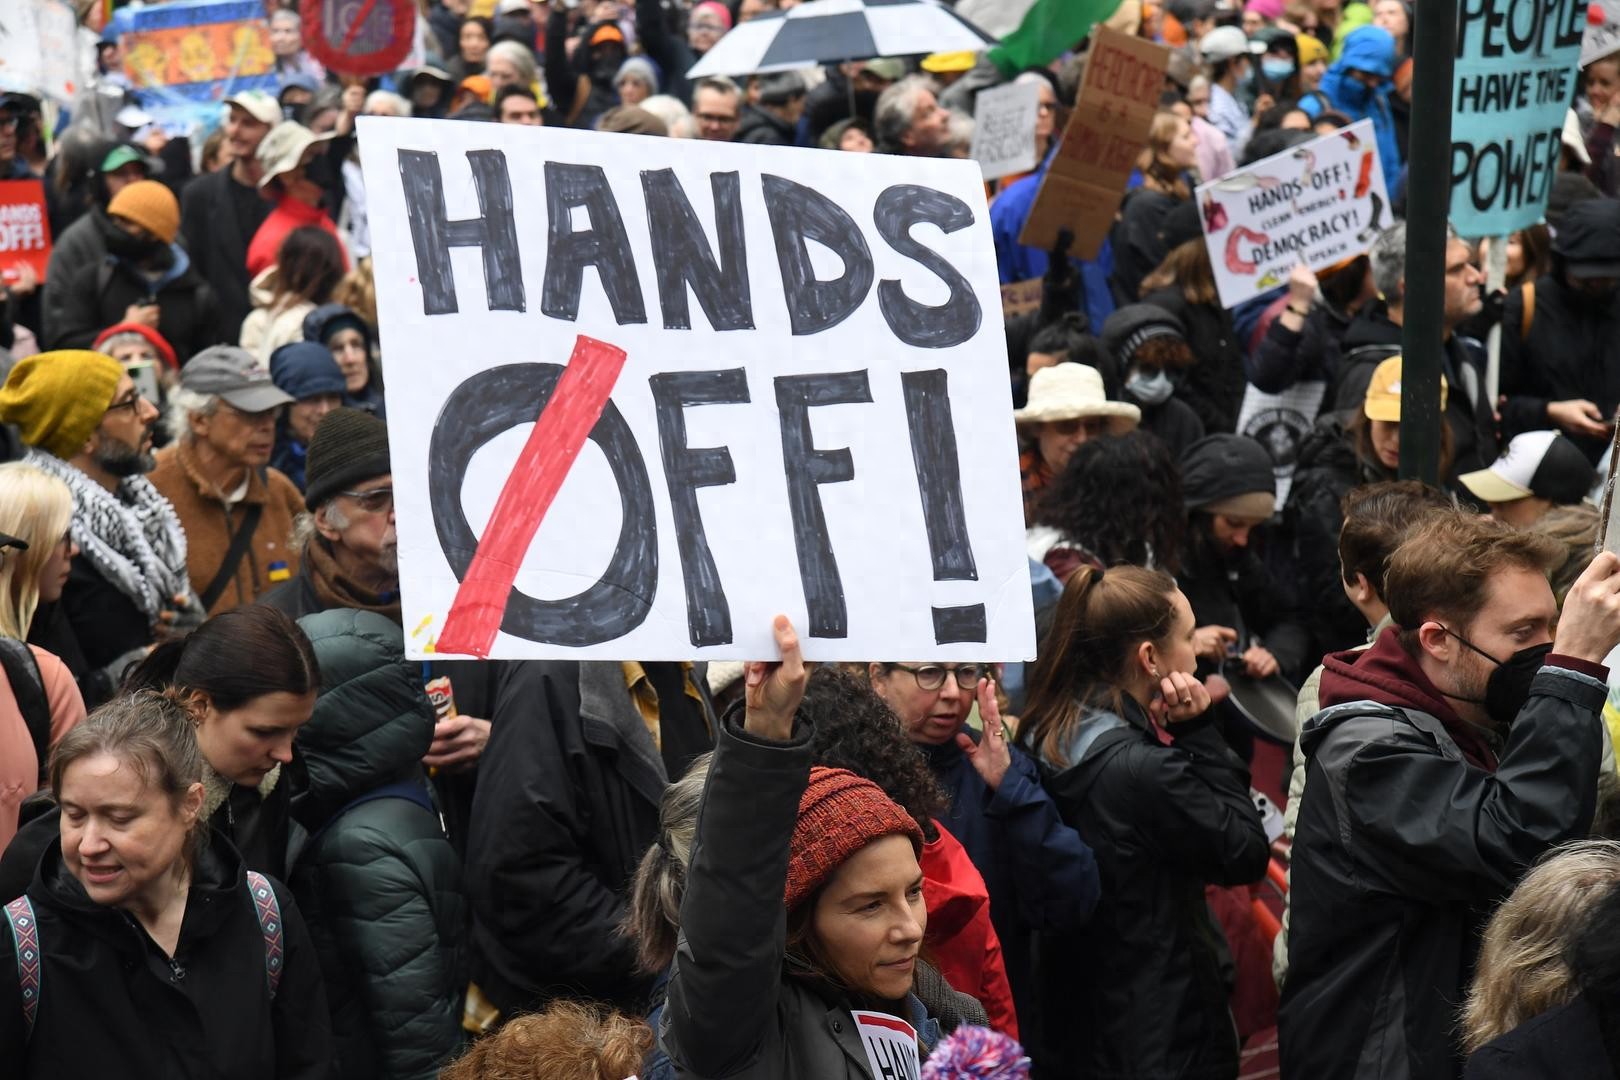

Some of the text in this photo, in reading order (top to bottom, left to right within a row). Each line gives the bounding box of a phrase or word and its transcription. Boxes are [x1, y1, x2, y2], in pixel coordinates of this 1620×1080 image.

[1456, 0, 1588, 58] PEOPLE
[1457, 67, 1571, 113] HAVE THE
[1248, 161, 1352, 215] HANDS OFF!
[1450, 128, 1562, 212] POWER
[397, 148, 982, 349] HANDS
[1251, 209, 1361, 265] DEMOCRACY!
[428, 362, 987, 647] OFF!
